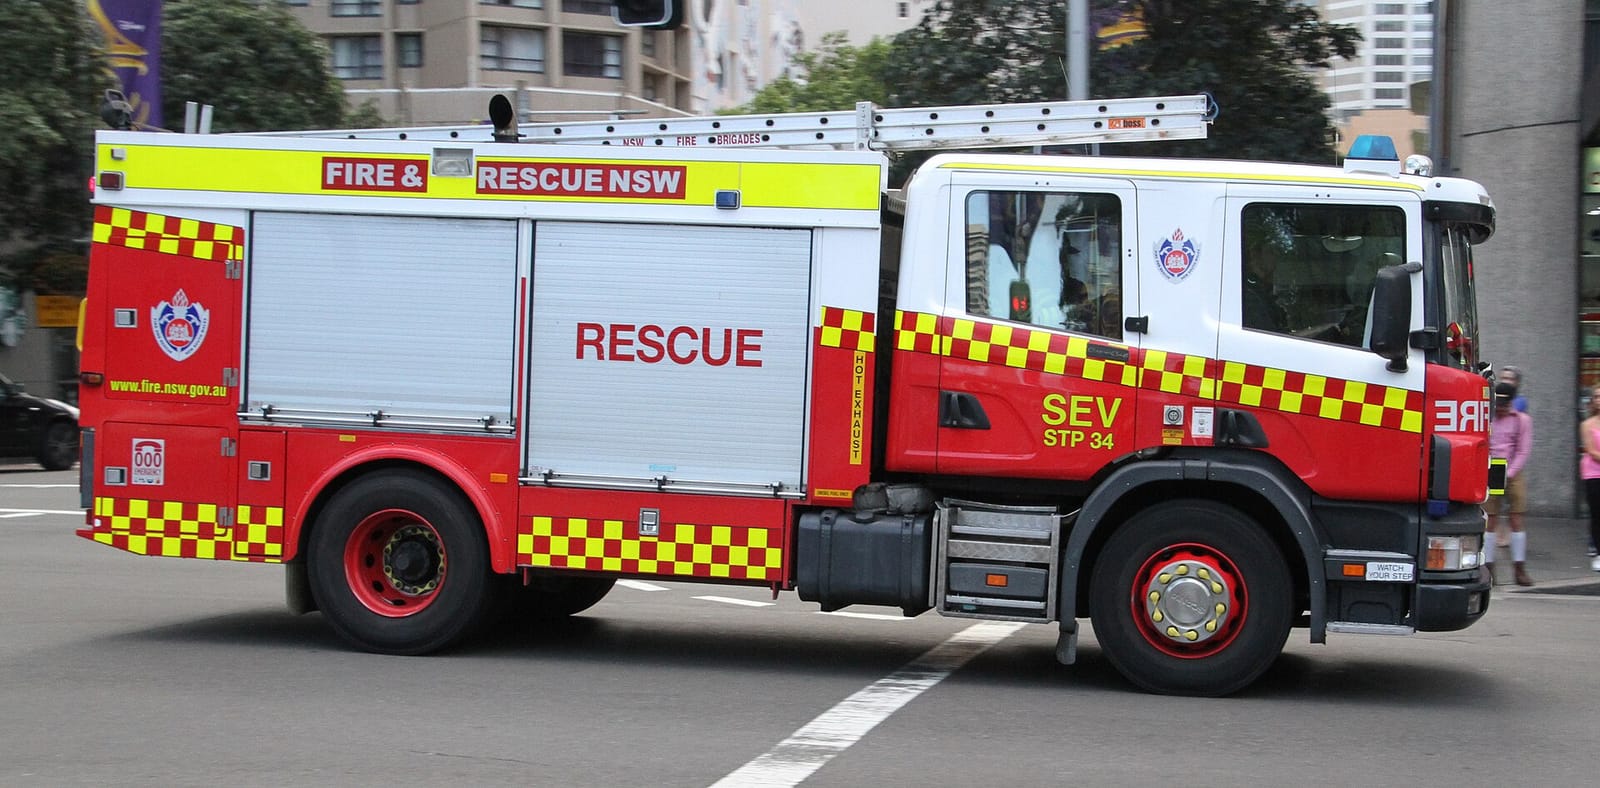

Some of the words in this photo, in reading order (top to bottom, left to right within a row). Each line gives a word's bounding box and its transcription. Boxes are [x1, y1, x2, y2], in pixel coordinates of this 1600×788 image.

[623, 138, 644, 146] NSW
[676, 136, 697, 146] FIRE
[717, 133, 761, 145] BRIGADES
[326, 162, 395, 187] FIRE
[401, 164, 424, 188] &
[478, 166, 603, 192] RESCUE
[609, 170, 681, 194] NSW
[576, 322, 764, 368] RESCUE
[855, 356, 864, 384] HOT
[110, 379, 227, 398] www.fire.nsw.gov.au
[1041, 393, 1122, 428] SEV
[852, 390, 862, 459] EXHAUST
[1043, 428, 1085, 448] STP
[1089, 432, 1114, 450] 34
[135, 452, 162, 468] 000
[1369, 571, 1390, 579] YOUR
[1392, 572, 1413, 580] STEP
[1377, 564, 1404, 572] WATCH
